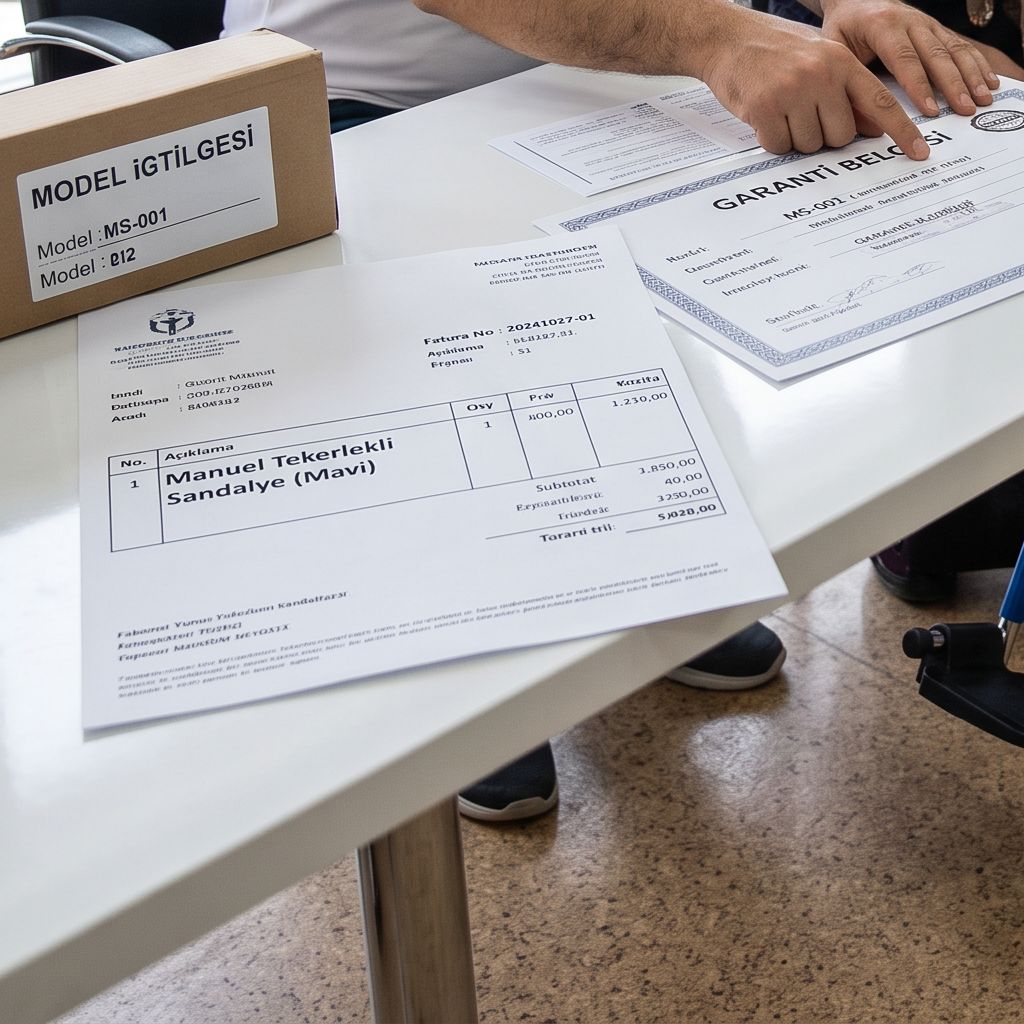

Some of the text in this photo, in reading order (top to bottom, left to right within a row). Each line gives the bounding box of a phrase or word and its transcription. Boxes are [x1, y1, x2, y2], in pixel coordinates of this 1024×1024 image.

[31, 166, 127, 209] MODEL
[37, 230, 93, 259] Model
[40, 258, 96, 288] Model
[473, 329, 494, 338] No
[506, 313, 596, 333] 20241027-01
[120, 443, 234, 468] No. Açıklama
[130, 437, 394, 489] 1 Manuel Tekerlekli
[167, 459, 376, 505] Sandalye (Mavi)
[664, 472, 703, 485] 40,00
